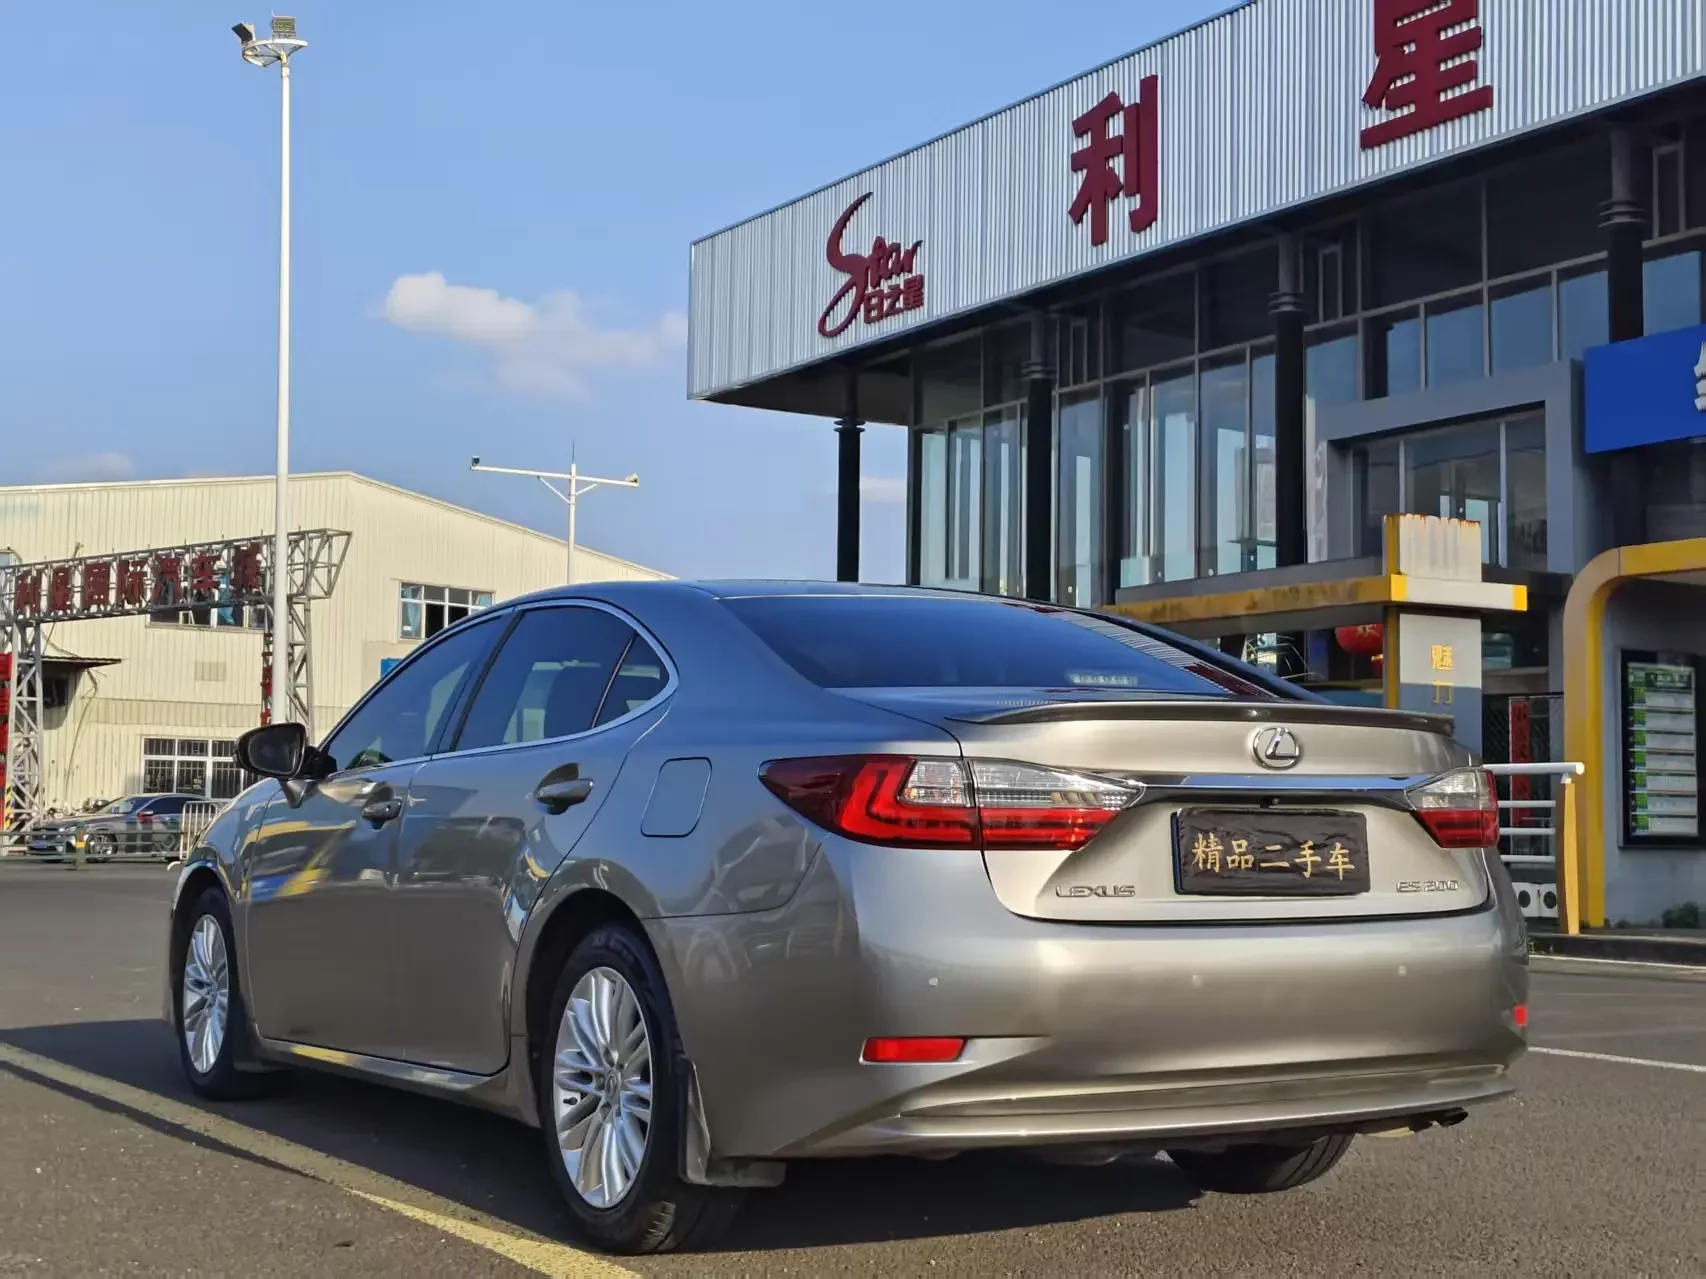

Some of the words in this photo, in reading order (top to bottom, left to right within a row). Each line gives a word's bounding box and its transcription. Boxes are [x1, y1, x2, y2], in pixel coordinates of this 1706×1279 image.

[818, 192, 923, 337] Star
[1192, 833, 1355, 881] 精品二手车
[1056, 885, 1136, 898] LEXUS
[1396, 880, 1421, 893] ES
[1423, 880, 1459, 892] 200
